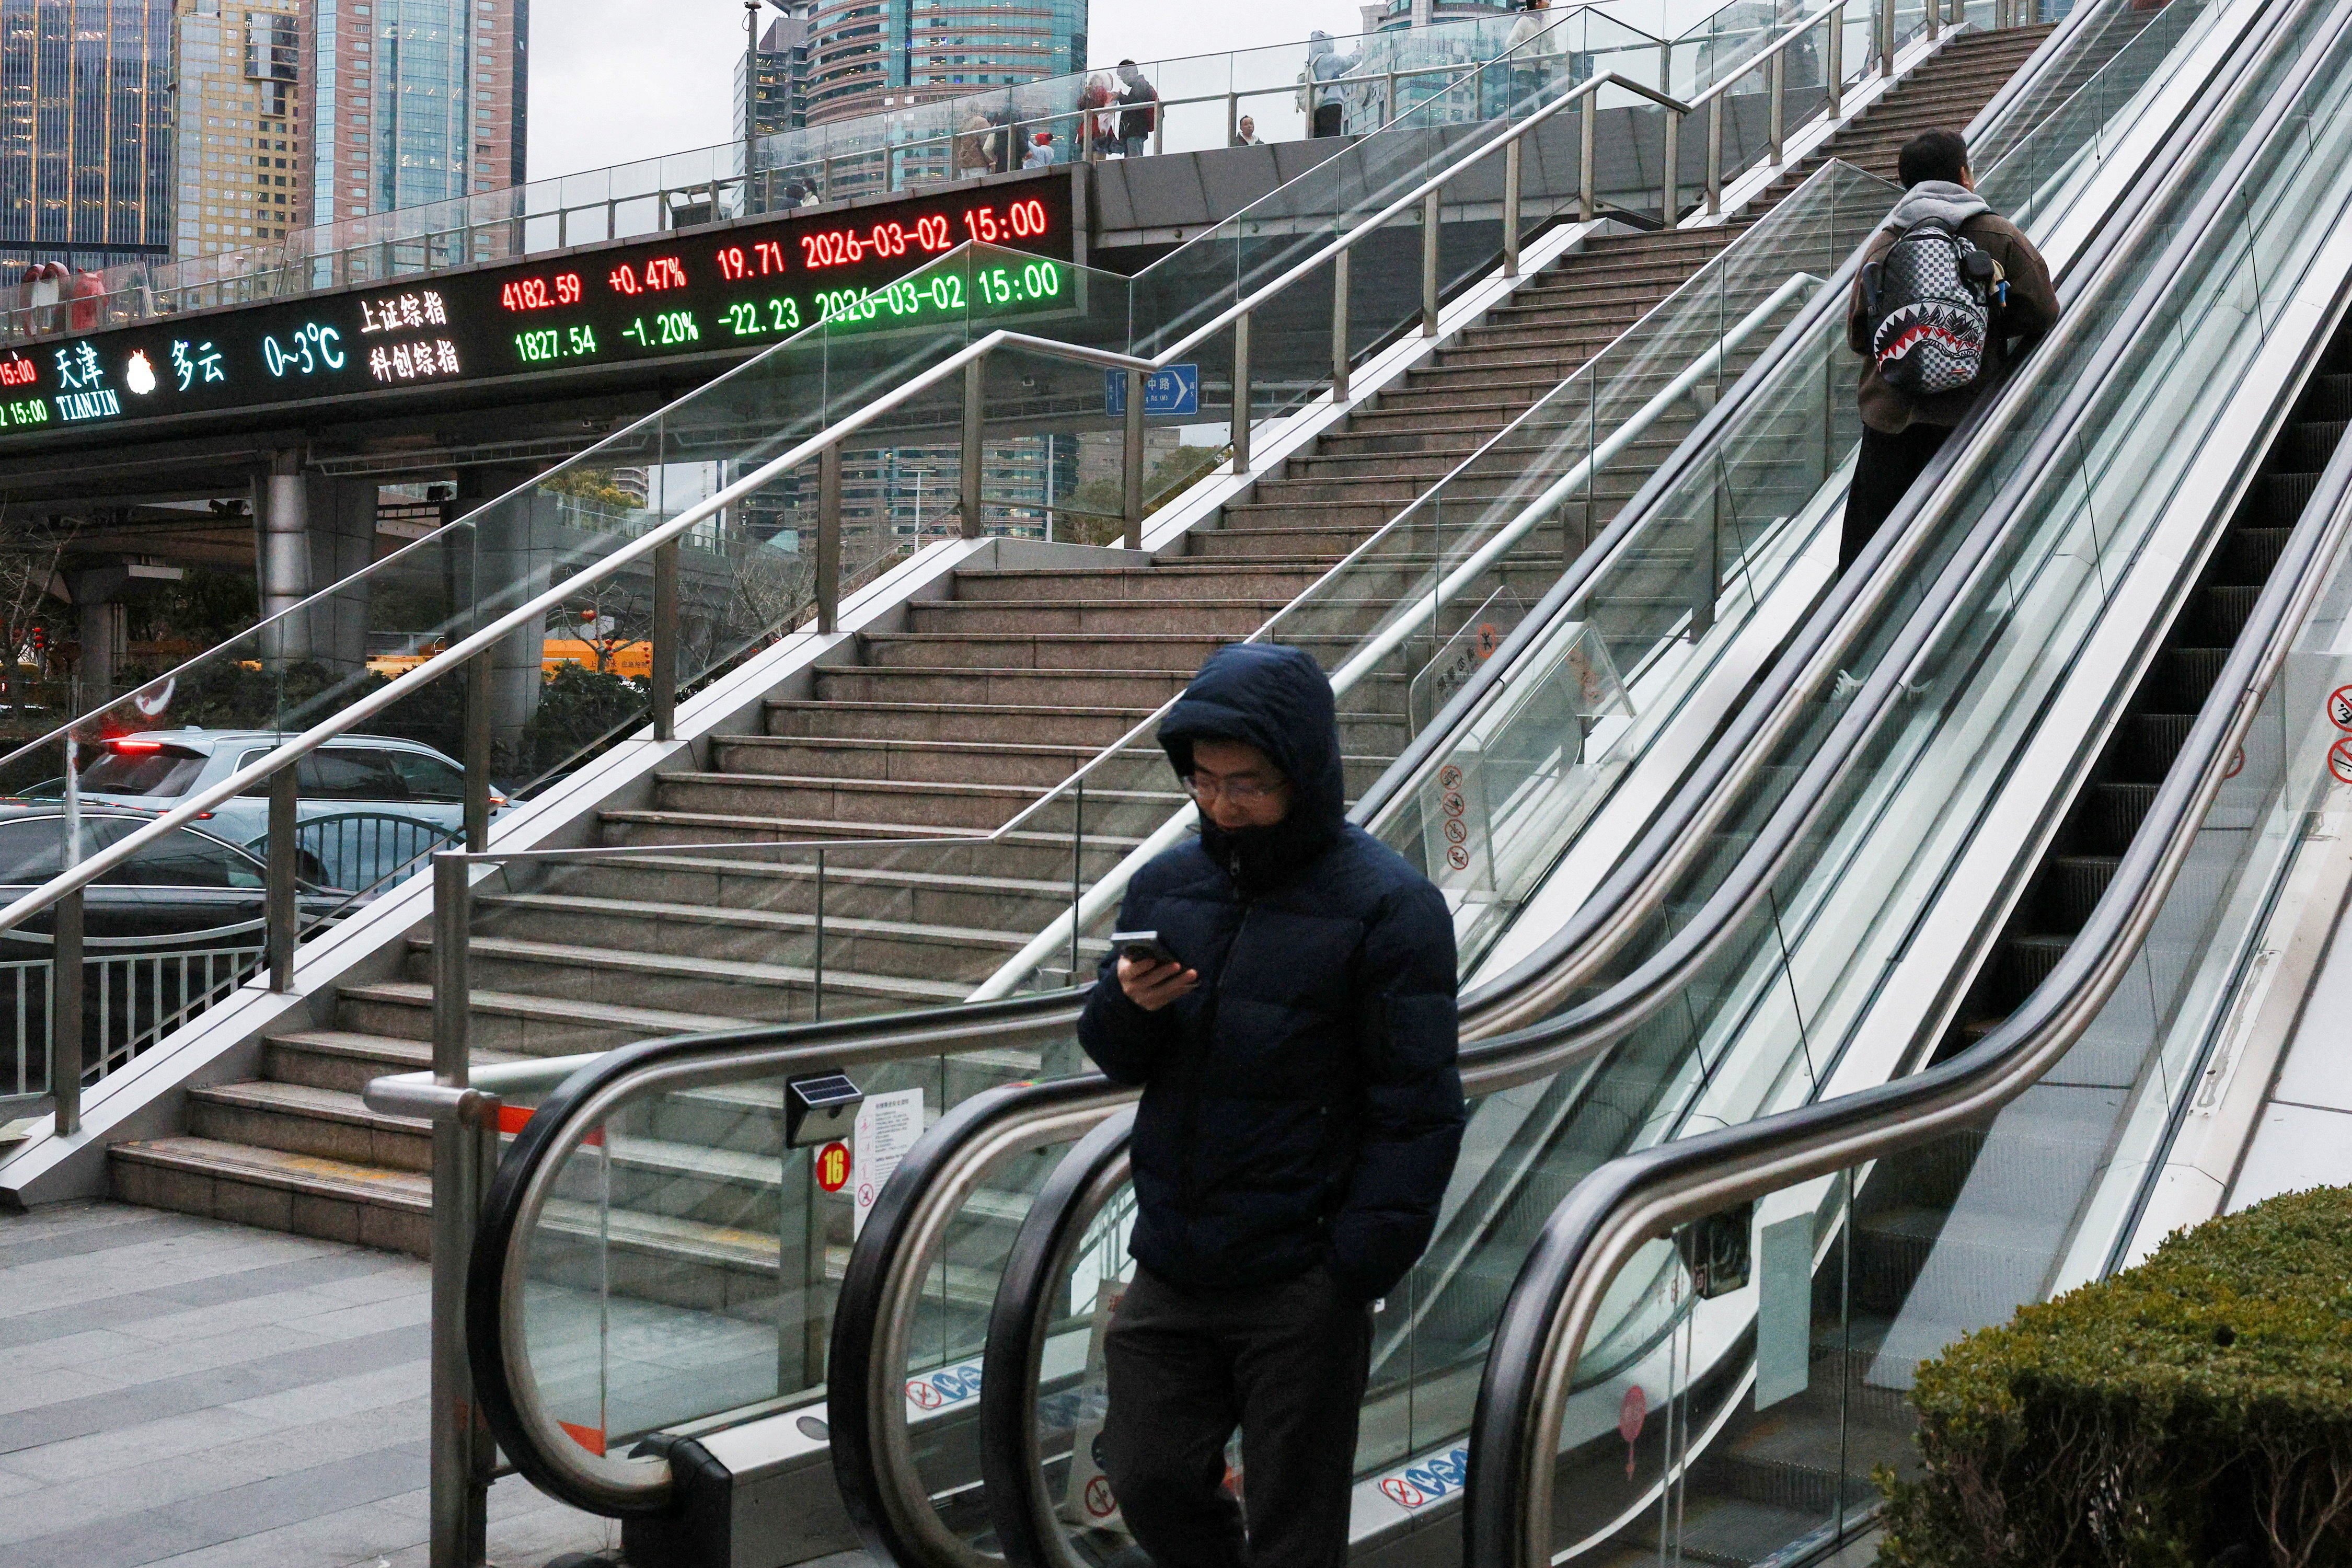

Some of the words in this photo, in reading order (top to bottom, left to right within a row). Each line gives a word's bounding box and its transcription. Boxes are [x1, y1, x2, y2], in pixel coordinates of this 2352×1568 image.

[361, 291, 446, 333] 上证综指
[502, 273, 581, 311] 4182.59
[609, 257, 687, 295] +0.47%
[717, 241, 784, 280] 19.71
[802, 215, 951, 268] 2026-03-02
[964, 200, 1046, 241] 15:00
[370, 339, 459, 383] 科创综指
[515, 325, 596, 361] 1827.54
[622, 312, 699, 346] -1.20%
[718, 297, 800, 335] -22.23
[815, 275, 965, 323] 2026-03-02
[978, 261, 1058, 304] 15:00
[0, 359, 36, 385] 15:00
[55, 341, 103, 389] 天津
[171, 340, 224, 391] 多云
[10, 399, 48, 424] 15:00
[56, 389, 120, 421] TIANJIN
[824, 1149, 844, 1185] 16
